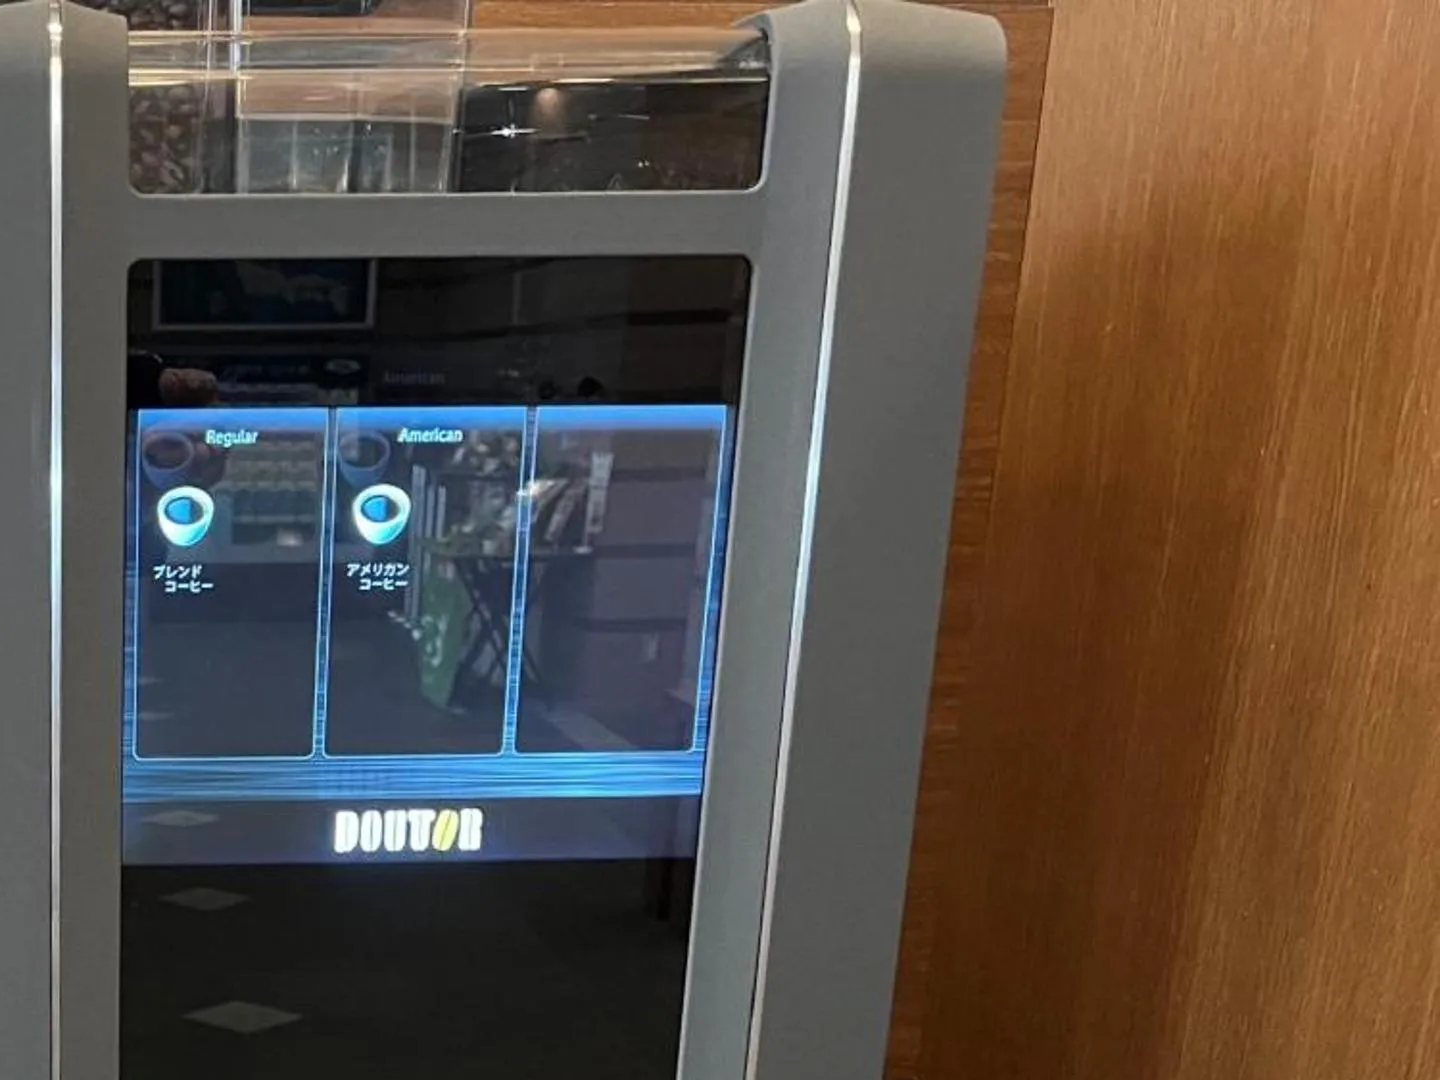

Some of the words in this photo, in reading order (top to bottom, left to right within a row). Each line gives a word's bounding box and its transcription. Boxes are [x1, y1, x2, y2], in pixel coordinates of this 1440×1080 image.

[205, 429, 259, 448] Regular
[397, 427, 464, 444] American
[153, 564, 203, 580] ブレンド
[346, 562, 410, 578] アメリカン
[164, 580, 214, 593] コーヒー
[359, 577, 409, 591] コーヒー
[334, 808, 483, 854] DOUTOR
